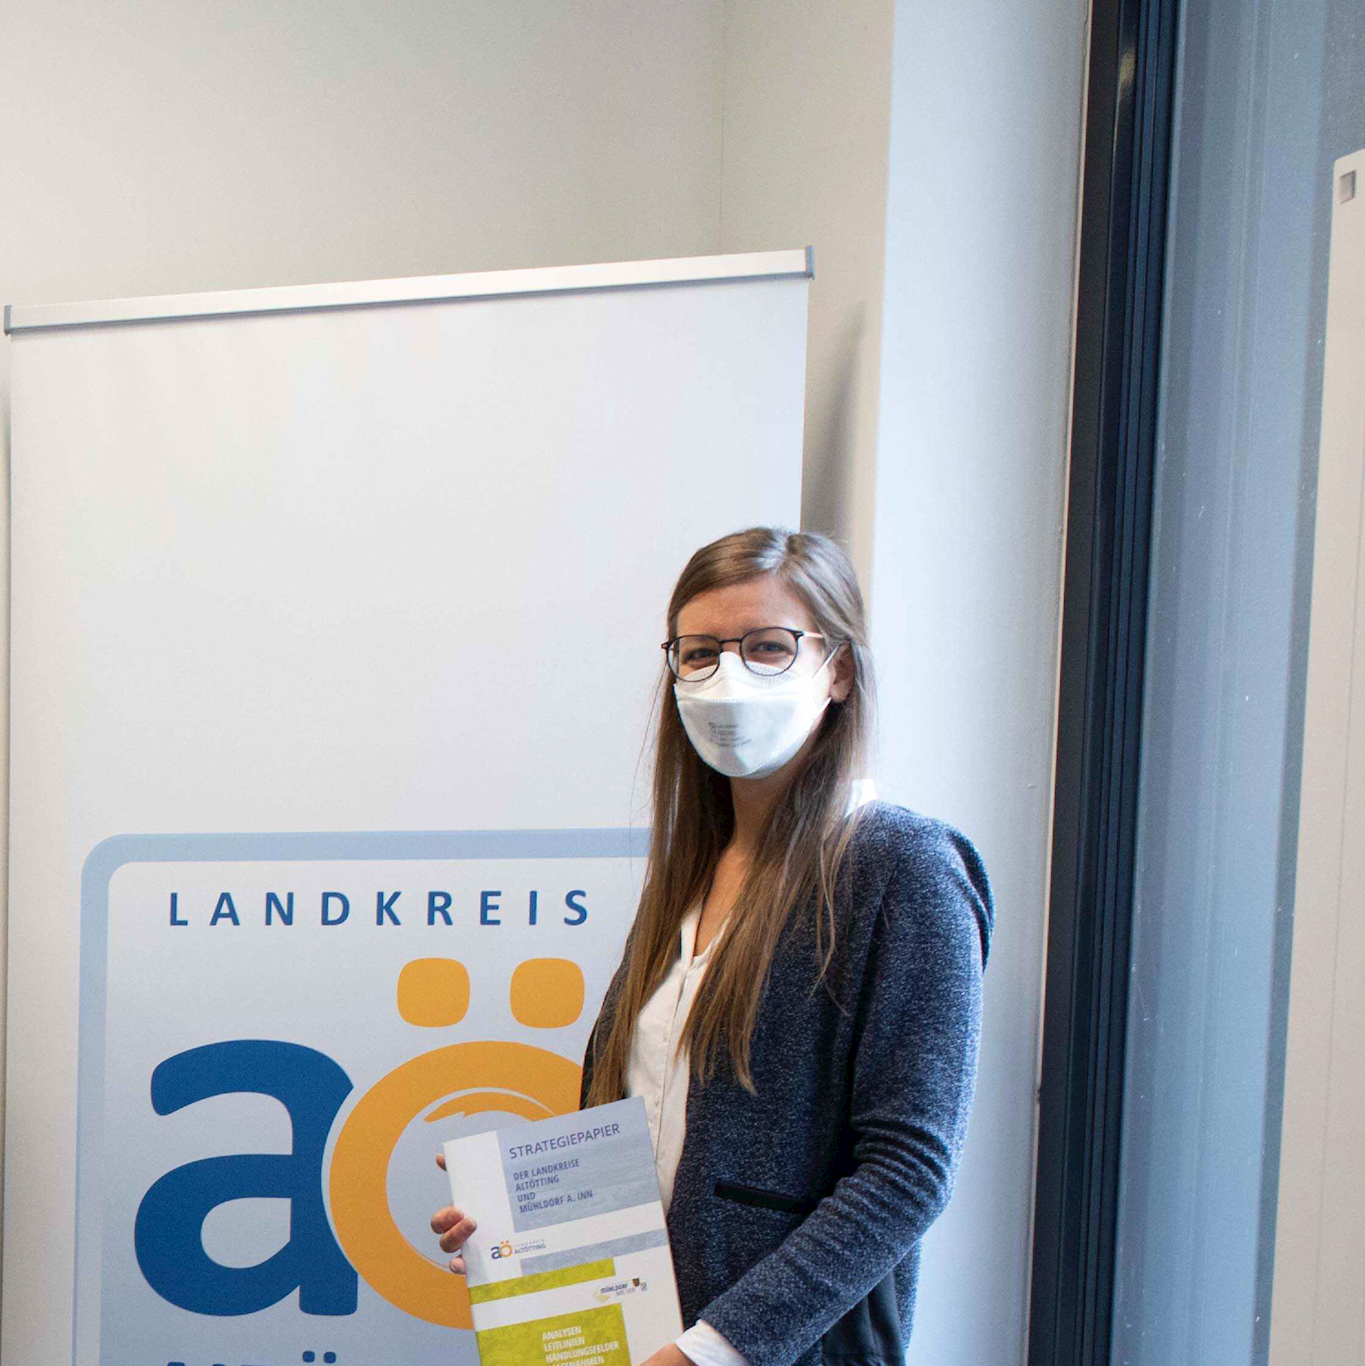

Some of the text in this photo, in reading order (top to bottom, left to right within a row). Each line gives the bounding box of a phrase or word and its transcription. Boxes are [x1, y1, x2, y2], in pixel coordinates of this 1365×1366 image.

[168, 889, 590, 927] LANDKREIS
[509, 1123, 621, 1159] STRATEGIEPAPIER
[513, 1158, 580, 1181] DER LANDKREISE
[516, 1175, 559, 1192] ALTÖTTING
[517, 1192, 535, 1203] UND
[519, 1190, 593, 1214] MÜHLDORF A. INN
[542, 1326, 582, 1341] ANALYSEN
[544, 1336, 585, 1352] LEITLINIEN
[545, 1341, 619, 1363] HANDLUNGSFELDER
